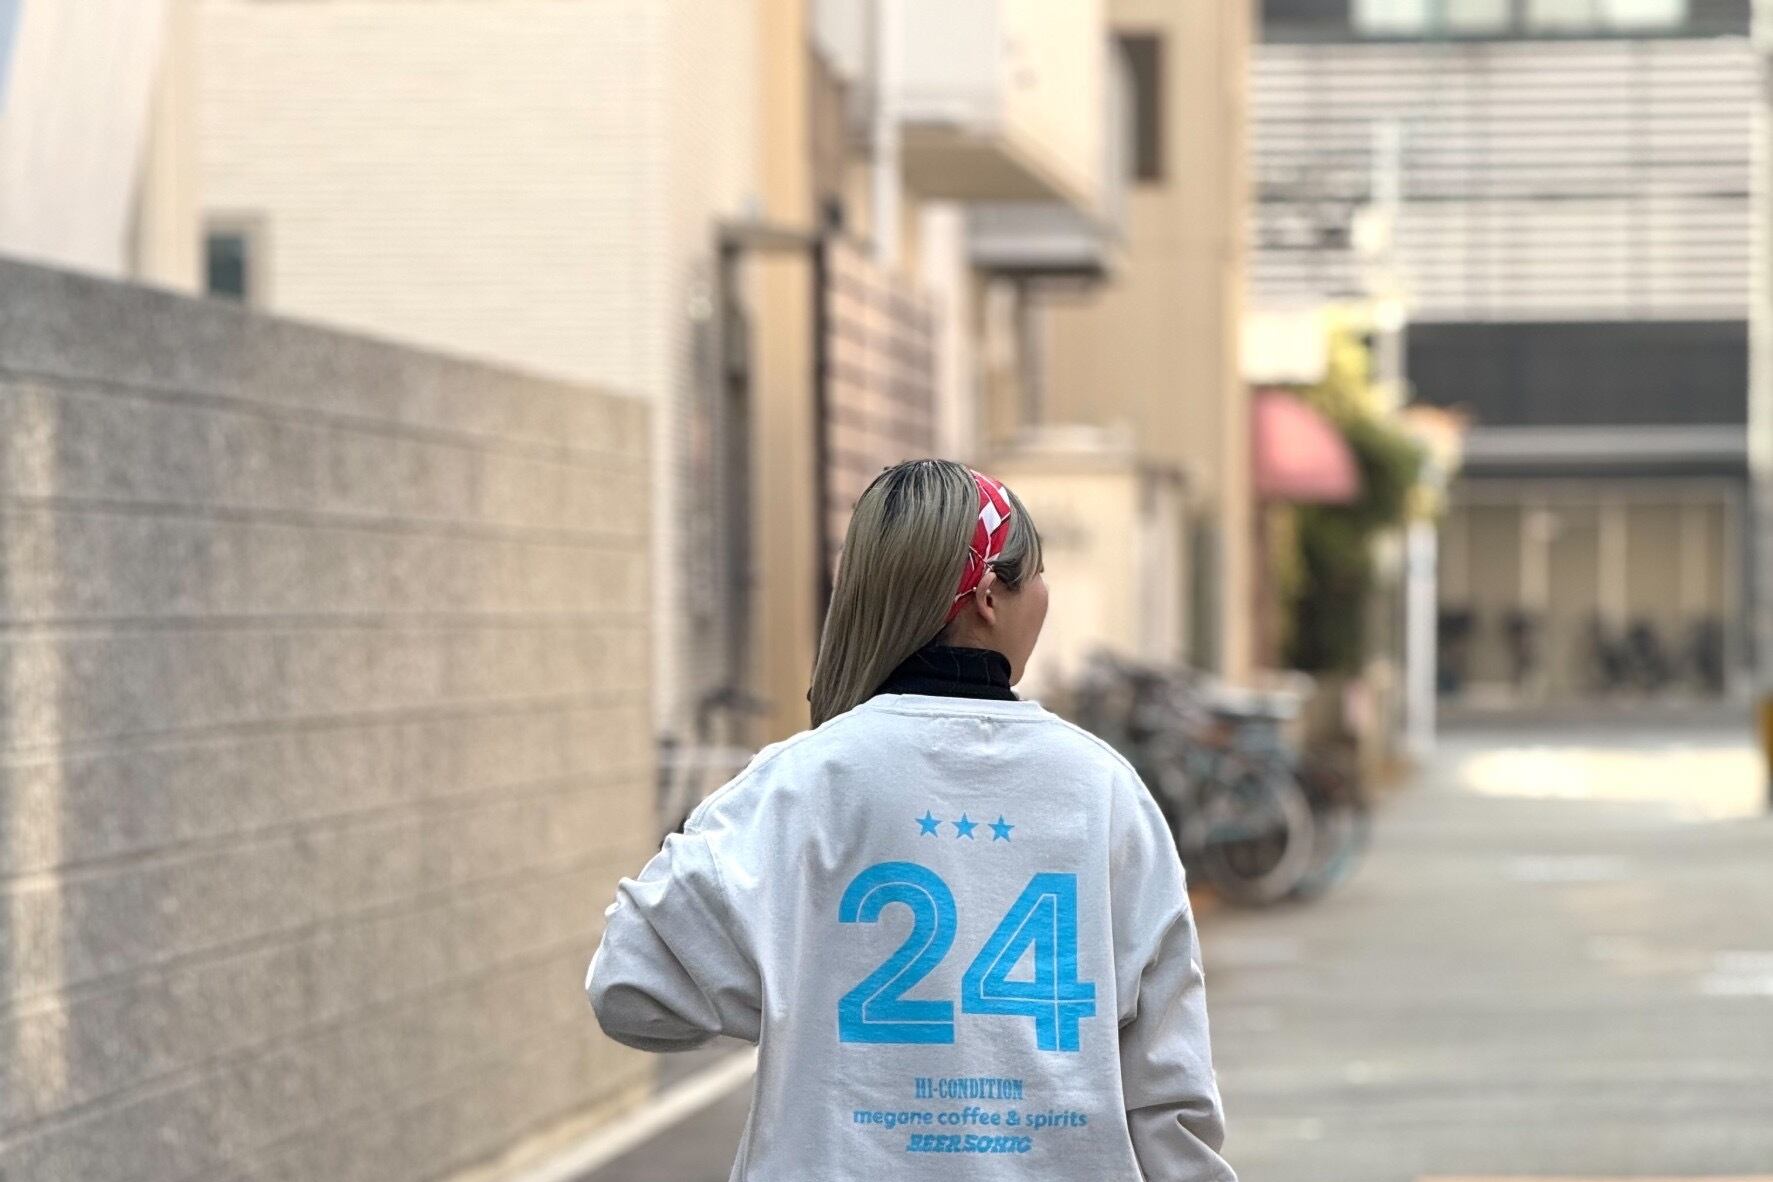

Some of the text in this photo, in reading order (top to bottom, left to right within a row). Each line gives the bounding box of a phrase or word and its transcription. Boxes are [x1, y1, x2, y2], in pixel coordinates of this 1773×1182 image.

[839, 861, 1096, 1052] 24
[915, 1077, 1023, 1101] HI-CONDITION
[854, 1107, 1088, 1131] megane coffee & spirits
